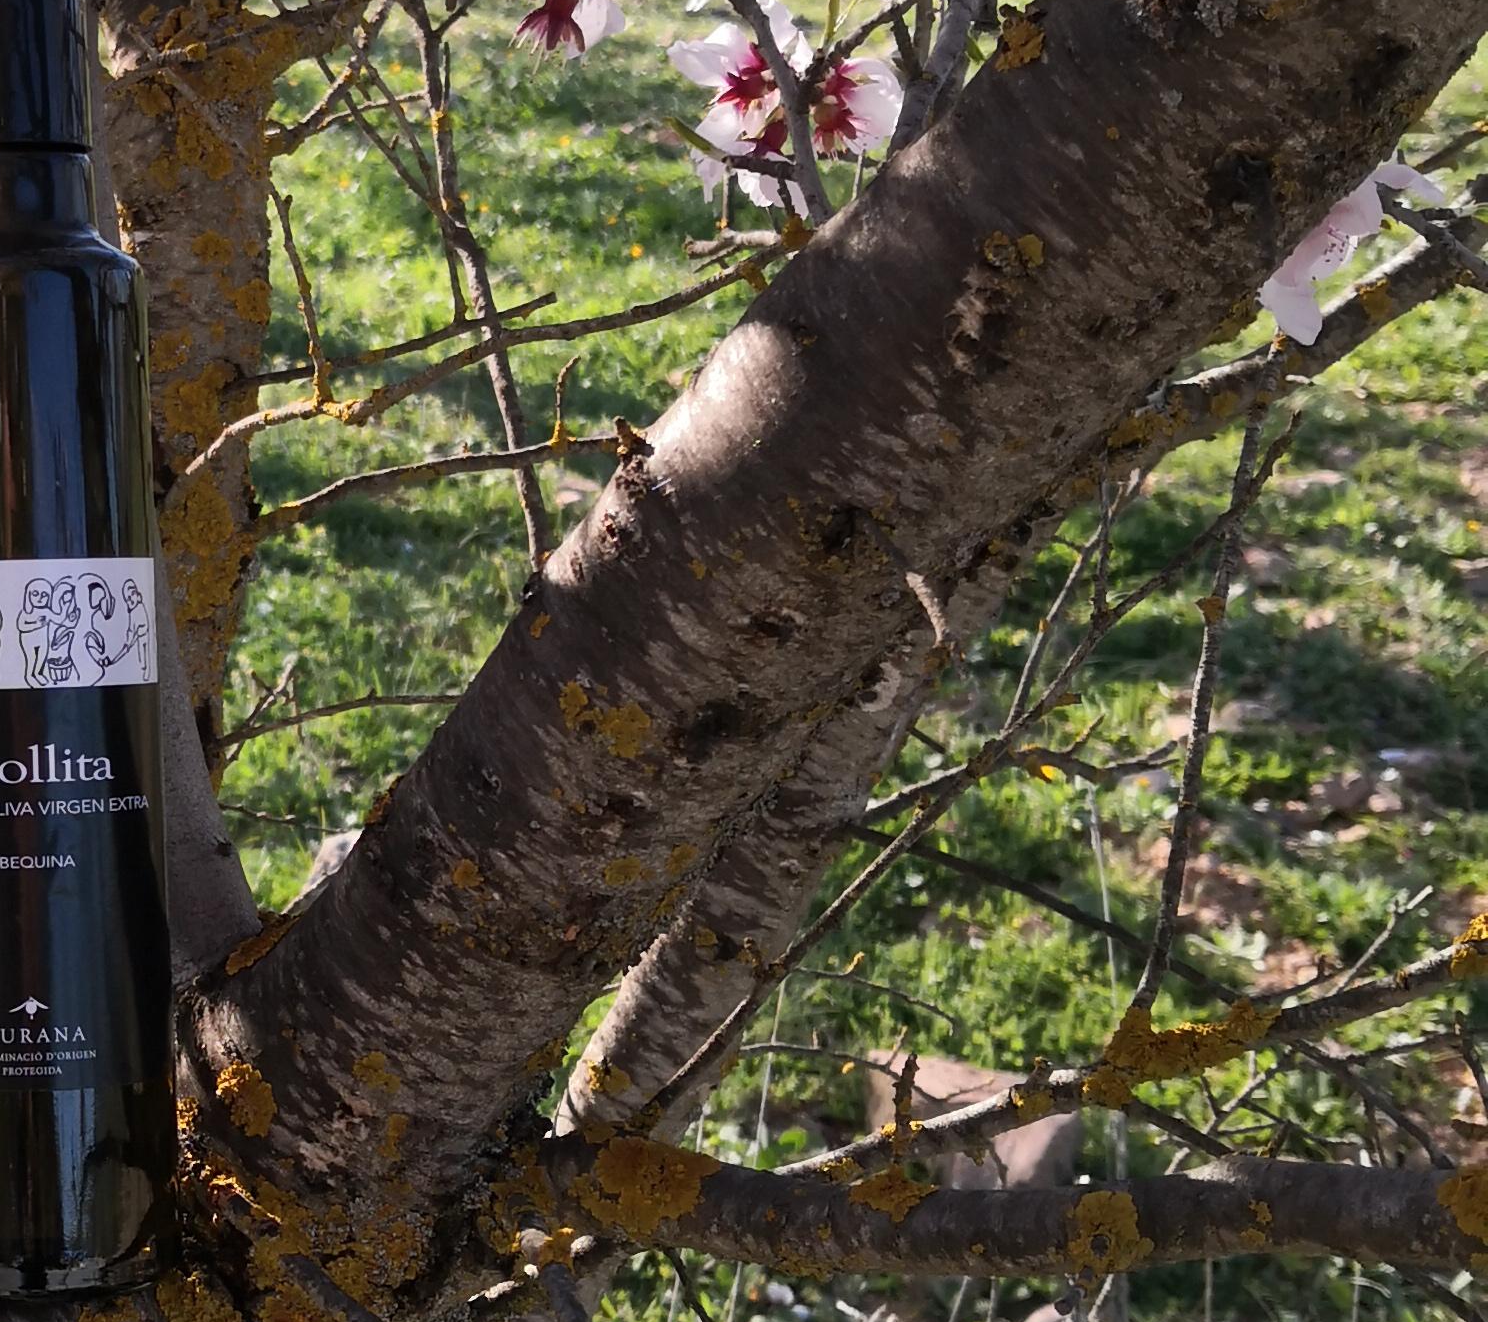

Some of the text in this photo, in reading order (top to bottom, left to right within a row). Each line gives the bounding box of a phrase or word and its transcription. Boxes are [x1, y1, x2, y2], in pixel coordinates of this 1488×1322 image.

[38, 798, 104, 816] VIRGEN
[108, 794, 149, 812] EXTRA
[46, 1049, 97, 1061] D'ORIGEN
[2, 1066, 63, 1076] PROTEGIDA
